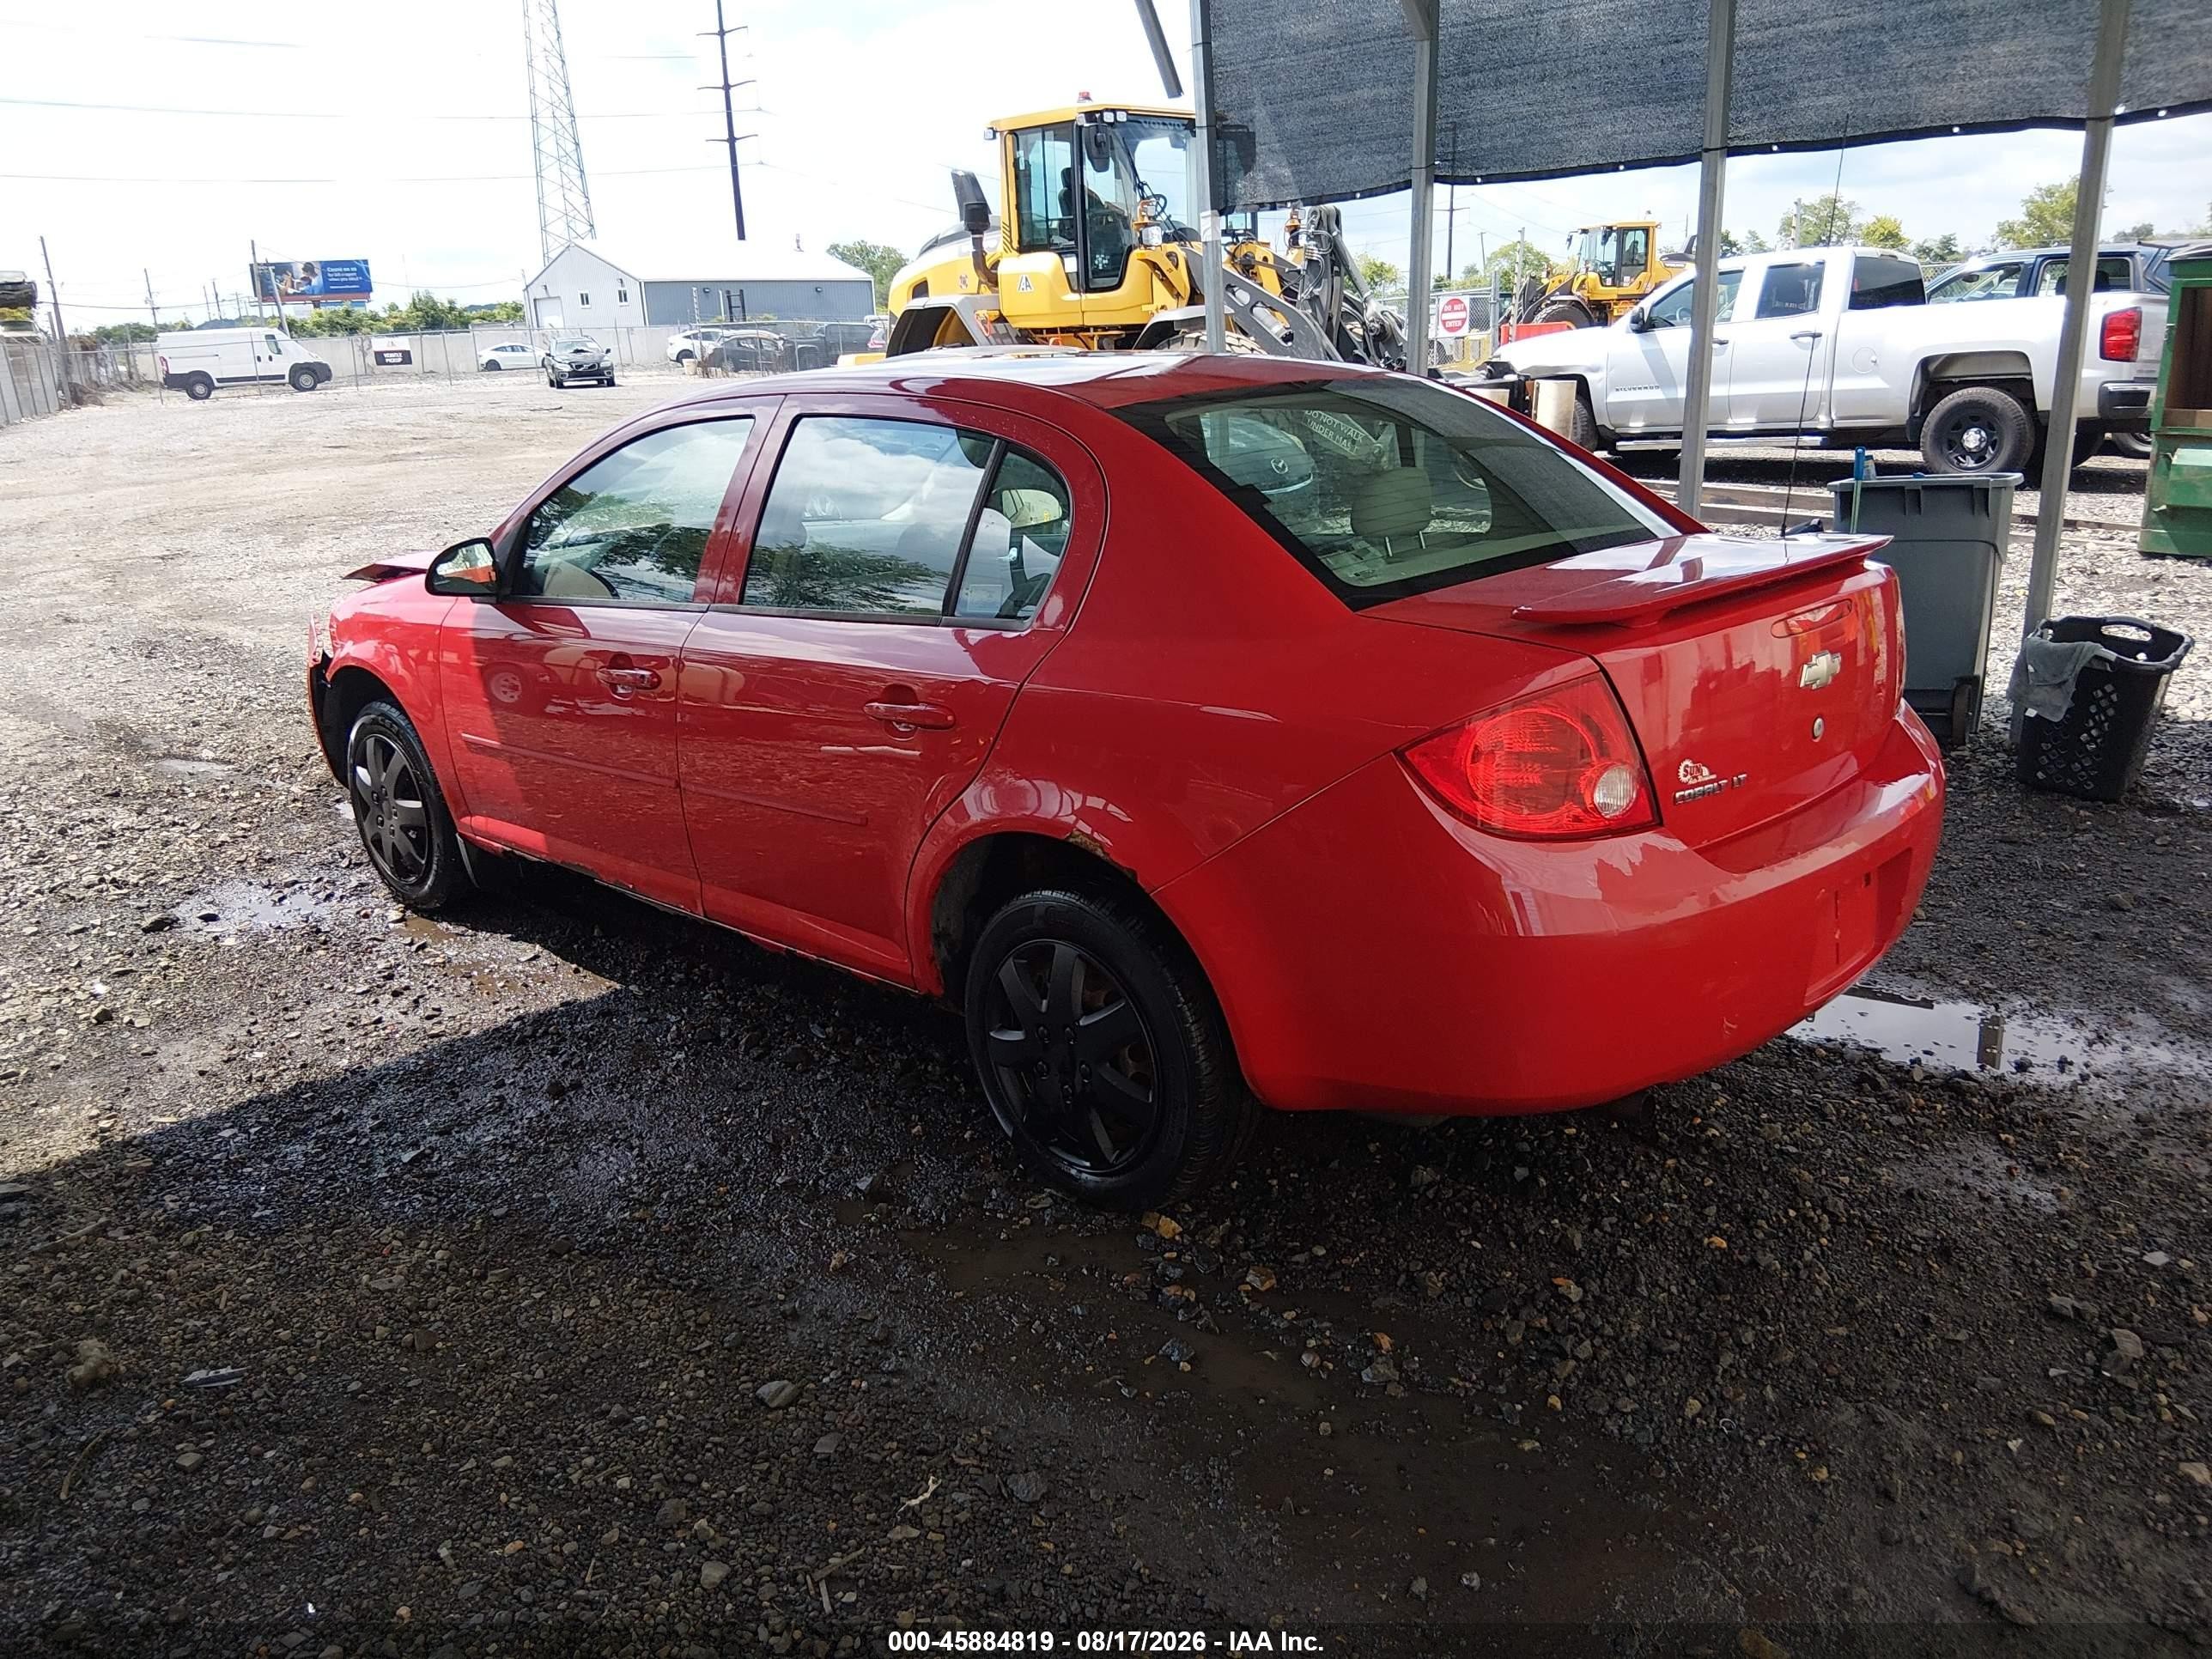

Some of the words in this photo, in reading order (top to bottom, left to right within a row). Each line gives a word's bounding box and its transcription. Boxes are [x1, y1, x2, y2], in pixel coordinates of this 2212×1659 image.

[1141, 119, 1183, 131] VOLVO
[1444, 304, 1452, 313] DO
[1307, 419, 1334, 440] UNDER
[1335, 435, 1359, 453] MAST
[1320, 416, 1337, 428] NOT
[1340, 422, 1364, 442] WALK
[1683, 763, 1703, 778] SUN
[1674, 779, 1728, 805] COBALT
[1732, 774, 1747, 789] LT
